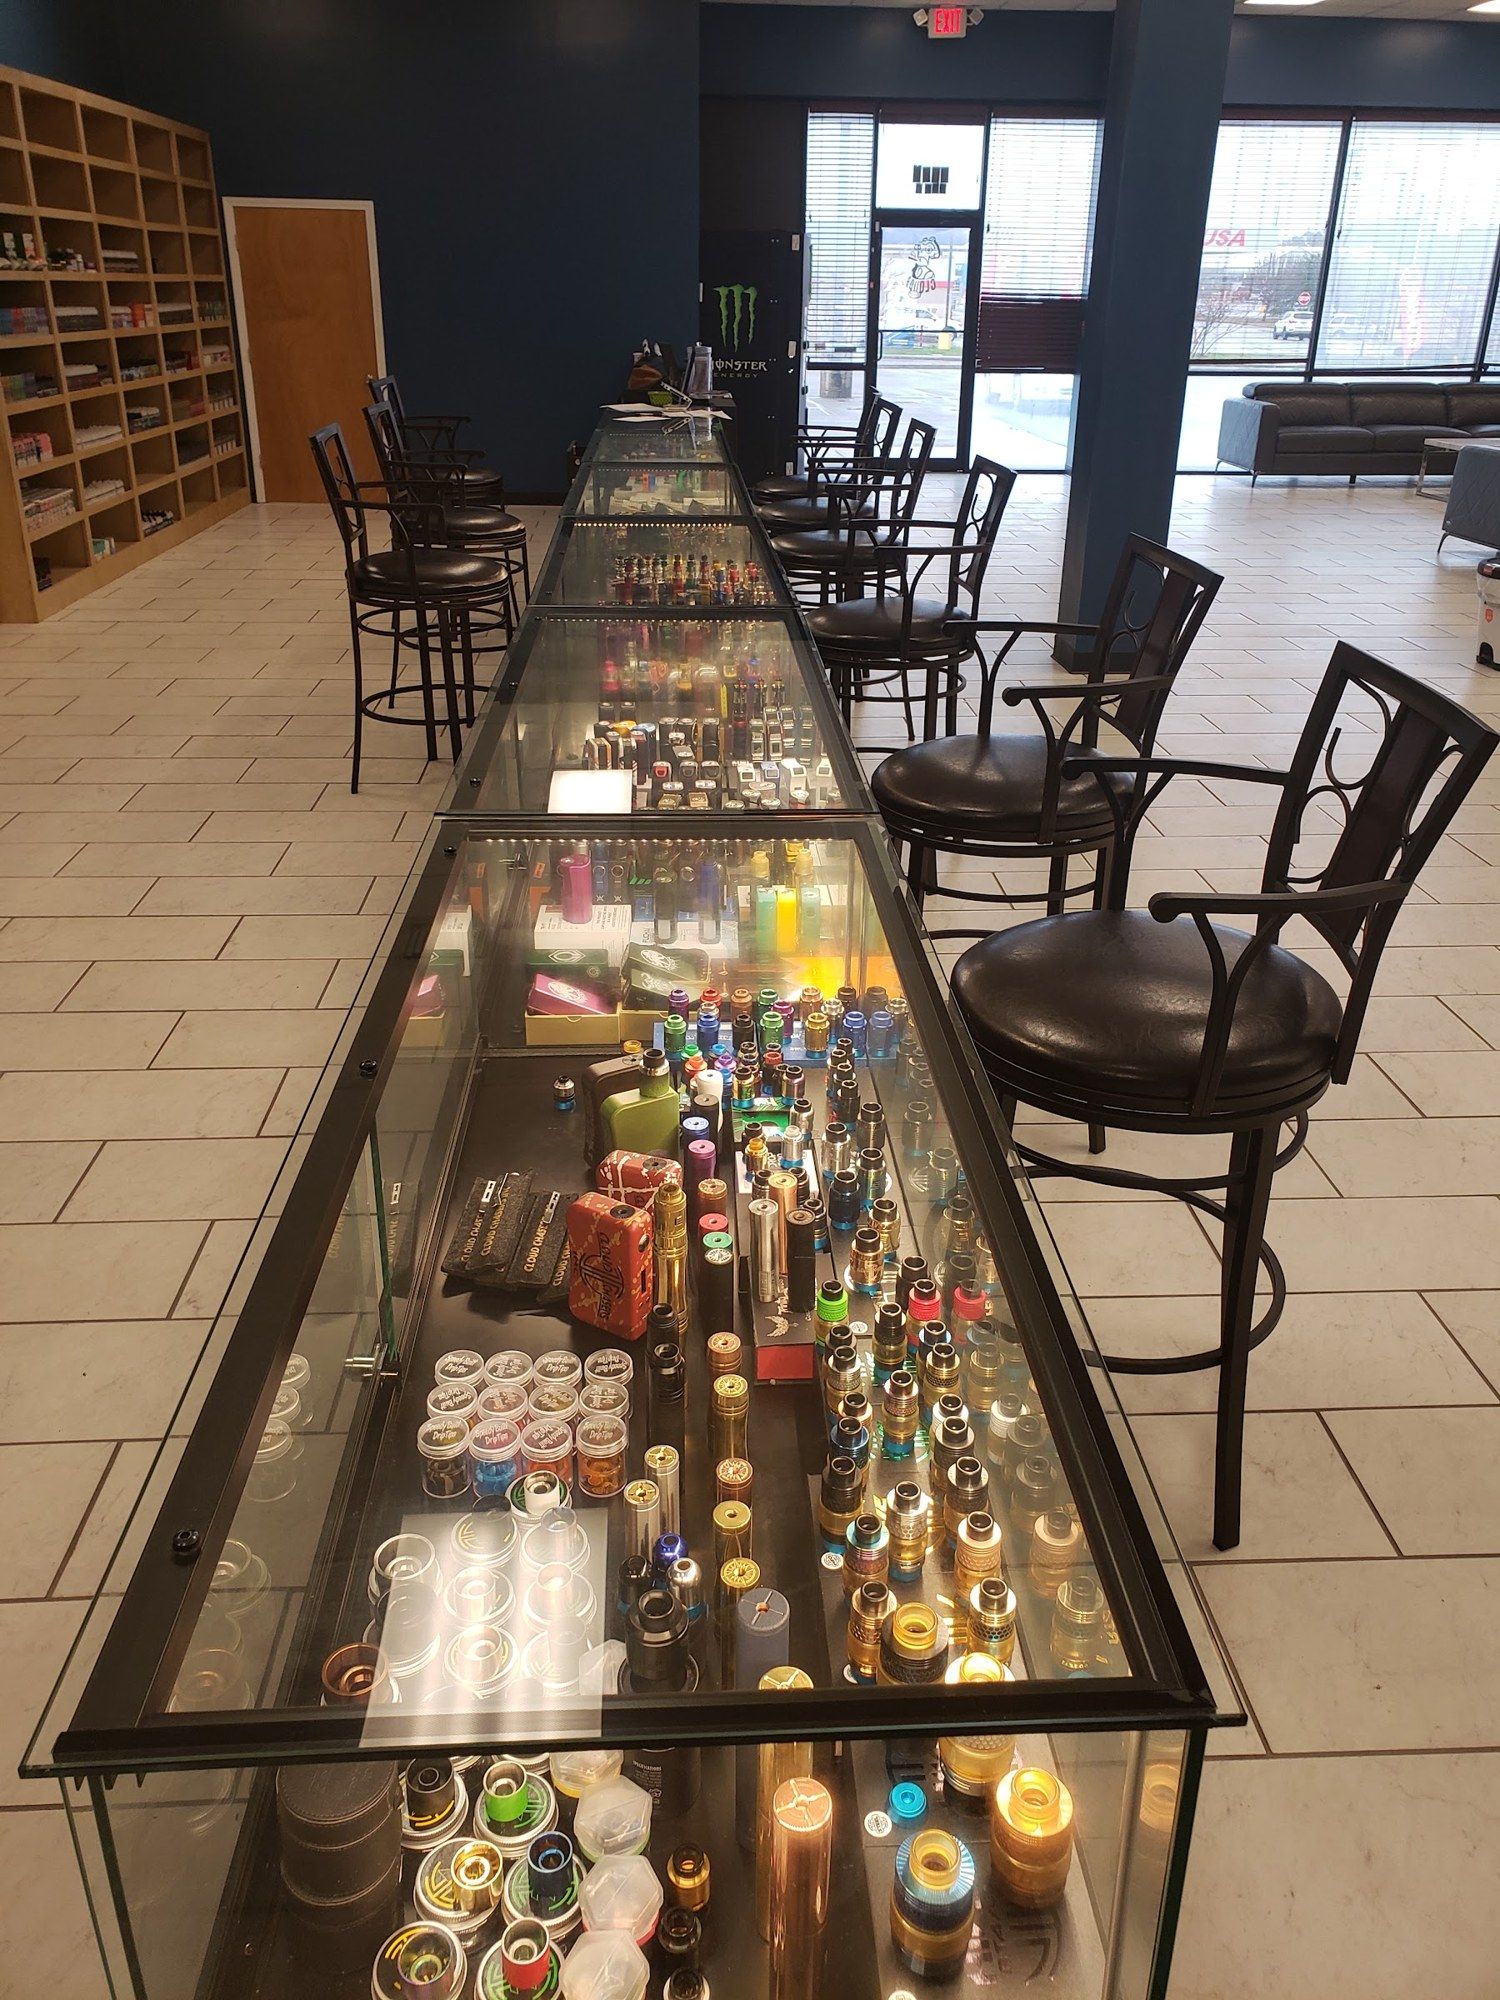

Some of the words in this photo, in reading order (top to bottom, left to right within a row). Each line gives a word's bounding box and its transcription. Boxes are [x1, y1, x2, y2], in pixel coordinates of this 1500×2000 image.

[935, 8, 962, 33] EXIT
[712, 358, 768, 371] ONSTER
[461, 1235, 476, 1262] CLOUD
[481, 1229, 497, 1256] CLOUD
[600, 1232, 612, 1273] CLOUD
[524, 1245, 540, 1272] CLOUD
[553, 1257, 568, 1286] CLOUD
